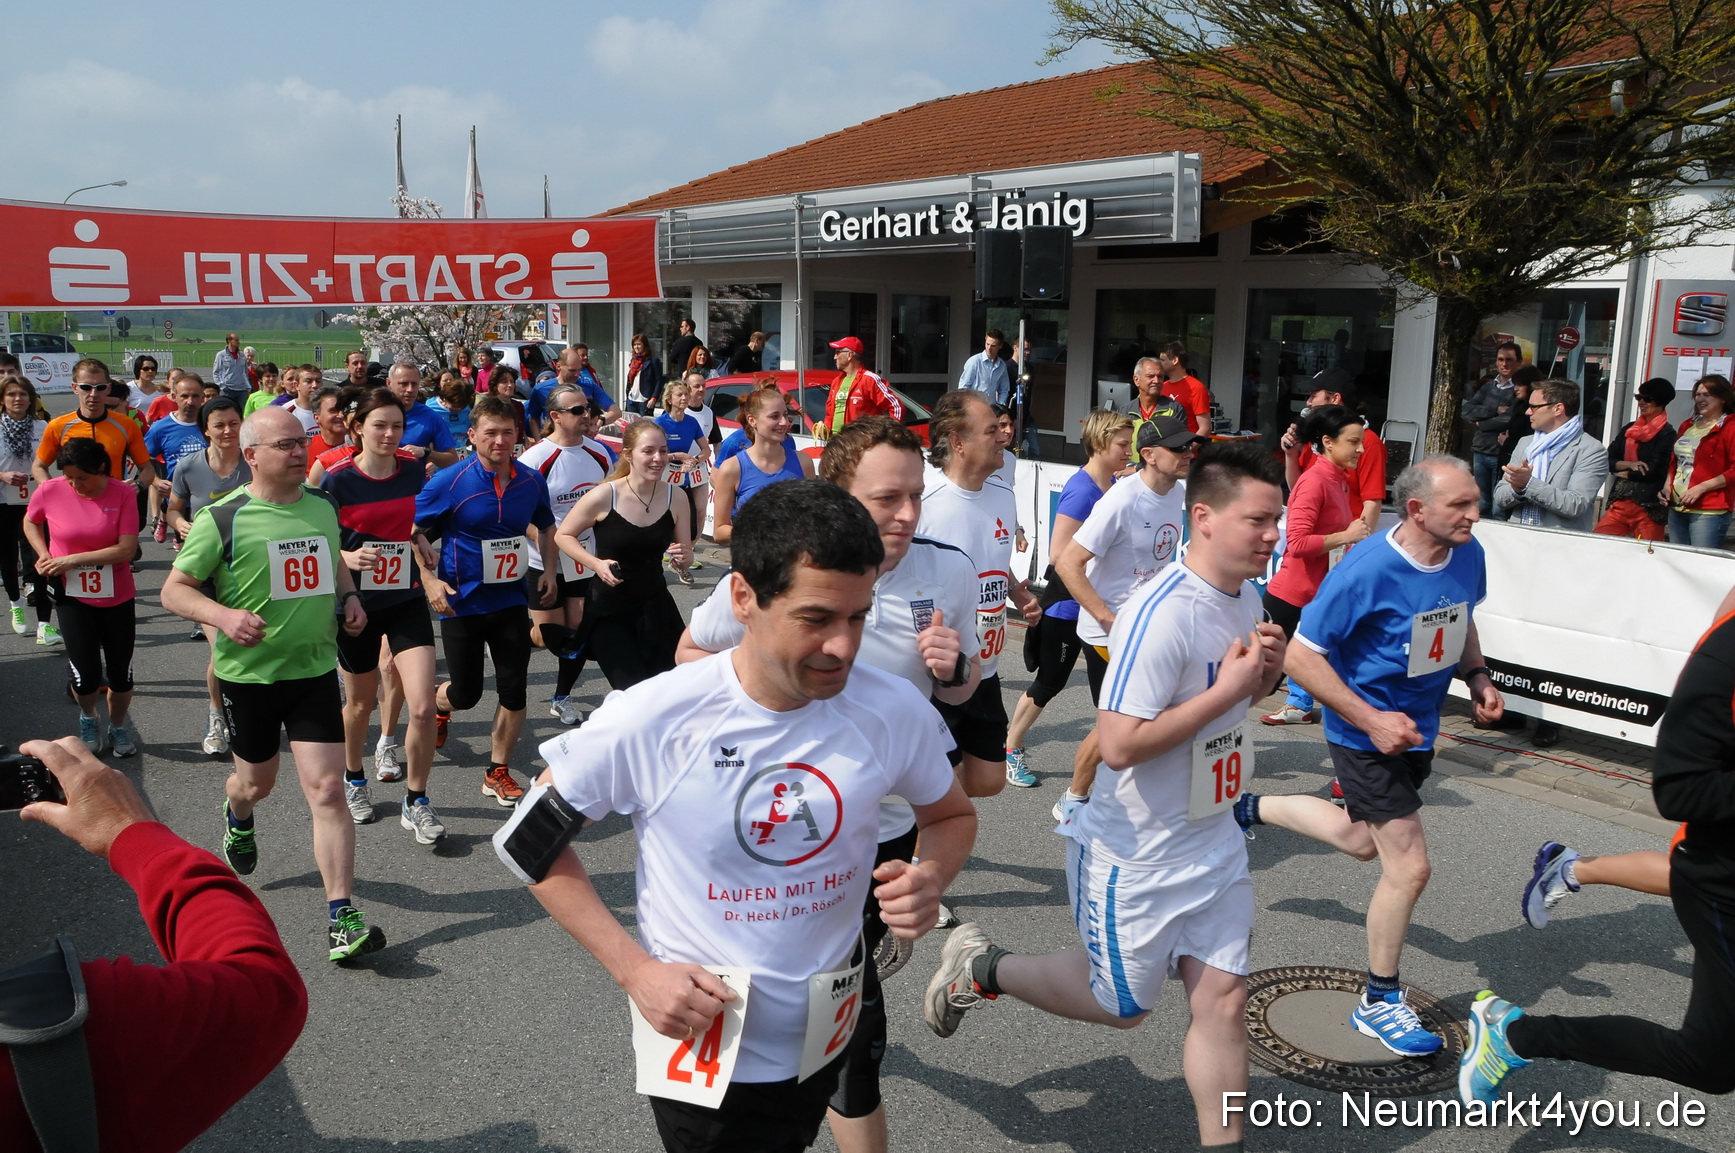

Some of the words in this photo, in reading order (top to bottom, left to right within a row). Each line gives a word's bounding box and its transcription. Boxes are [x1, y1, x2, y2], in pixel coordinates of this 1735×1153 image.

[820, 205, 943, 242] Gerhart
[951, 201, 974, 233] &
[986, 191, 1087, 237] Jänig
[1663, 347, 1730, 356] SEAT
[667, 470, 682, 484] 78
[691, 470, 702, 484] 18
[278, 541, 307, 550] MEYER
[490, 540, 513, 548] MEYER
[284, 555, 320, 593] 69
[372, 556, 402, 584] 92
[493, 553, 518, 580] 72
[78, 571, 102, 594] 13
[1422, 611, 1448, 623] MEYER
[980, 625, 1005, 659] 30
[1428, 627, 1445, 663] 4
[1538, 682, 1562, 697] die
[1566, 687, 1649, 716] verbinden
[1205, 732, 1233, 751] MEYER
[714, 759, 745, 768] erima
[1212, 751, 1241, 804] 19
[725, 911, 743, 922] Dr.
[747, 909, 780, 922] Heck
[792, 906, 809, 917] Dr.
[667, 1010, 724, 1089] 24
